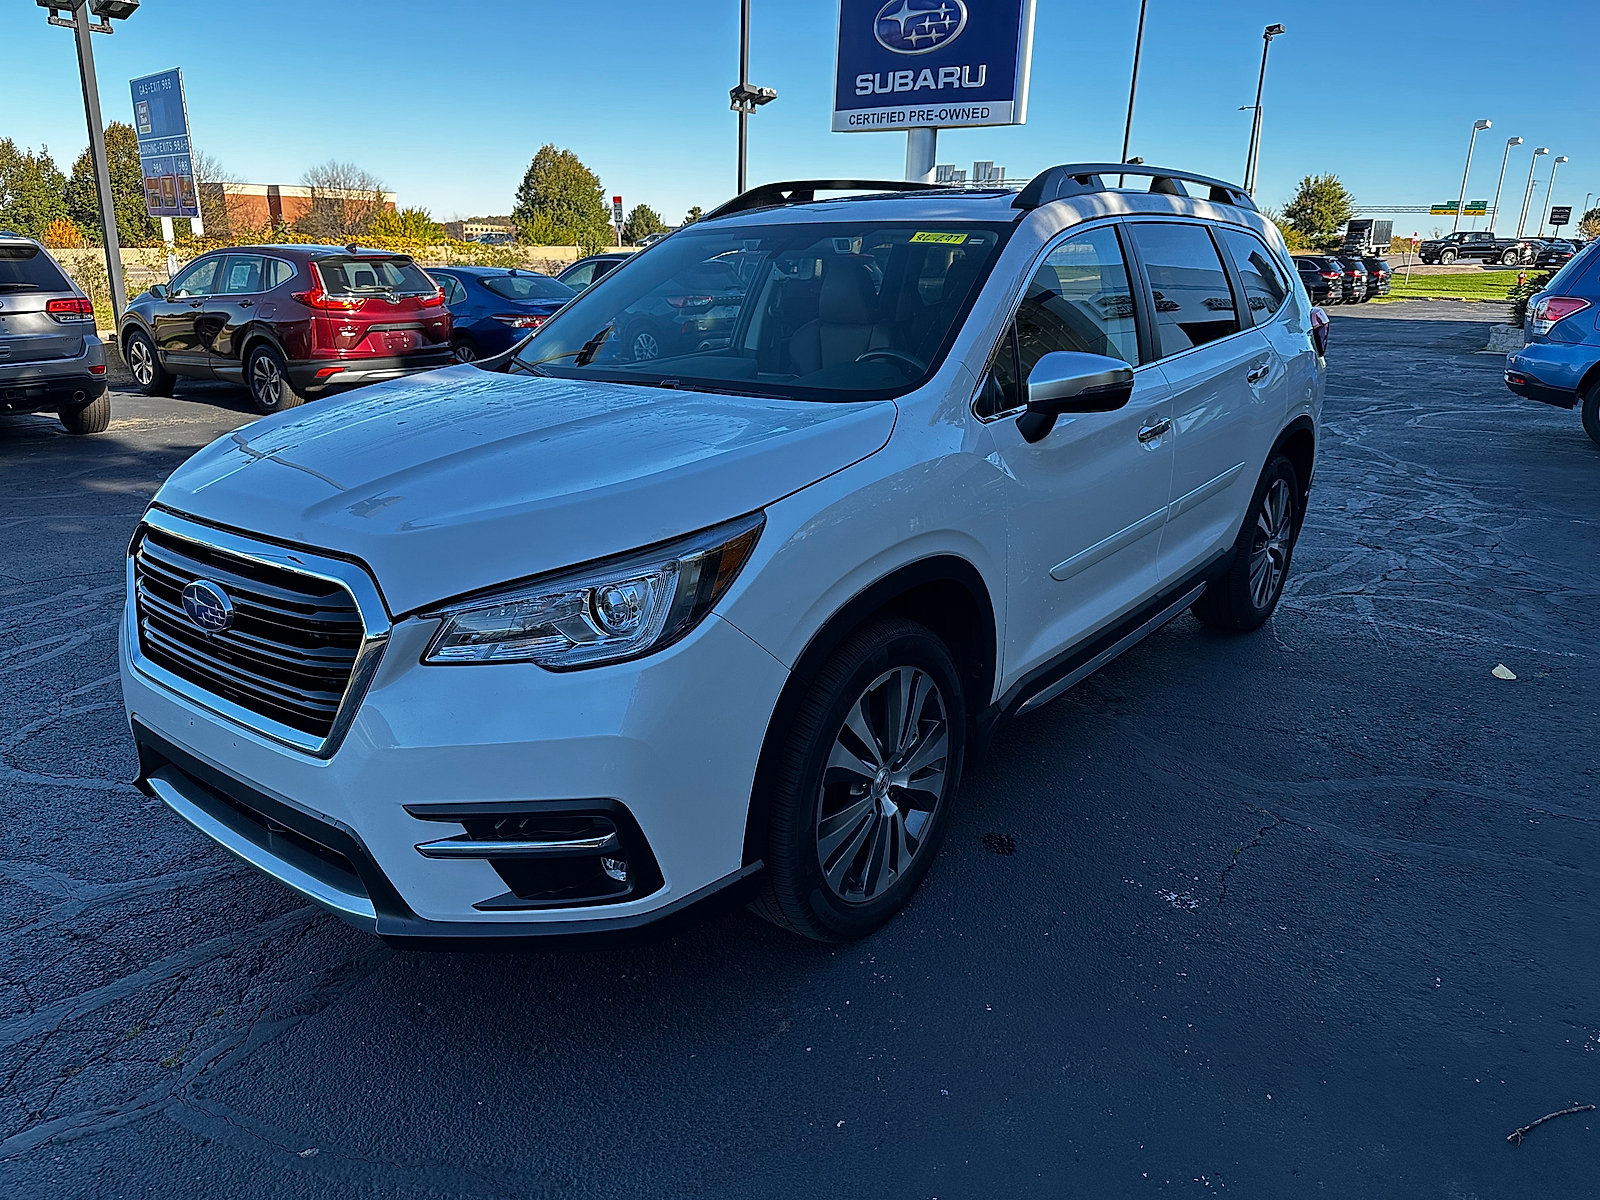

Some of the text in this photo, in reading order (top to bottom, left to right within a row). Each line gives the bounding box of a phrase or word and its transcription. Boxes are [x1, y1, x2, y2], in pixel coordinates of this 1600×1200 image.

[855, 64, 987, 96] SUBARU
[848, 107, 990, 126] CERTIFIED PRE-OWNED
